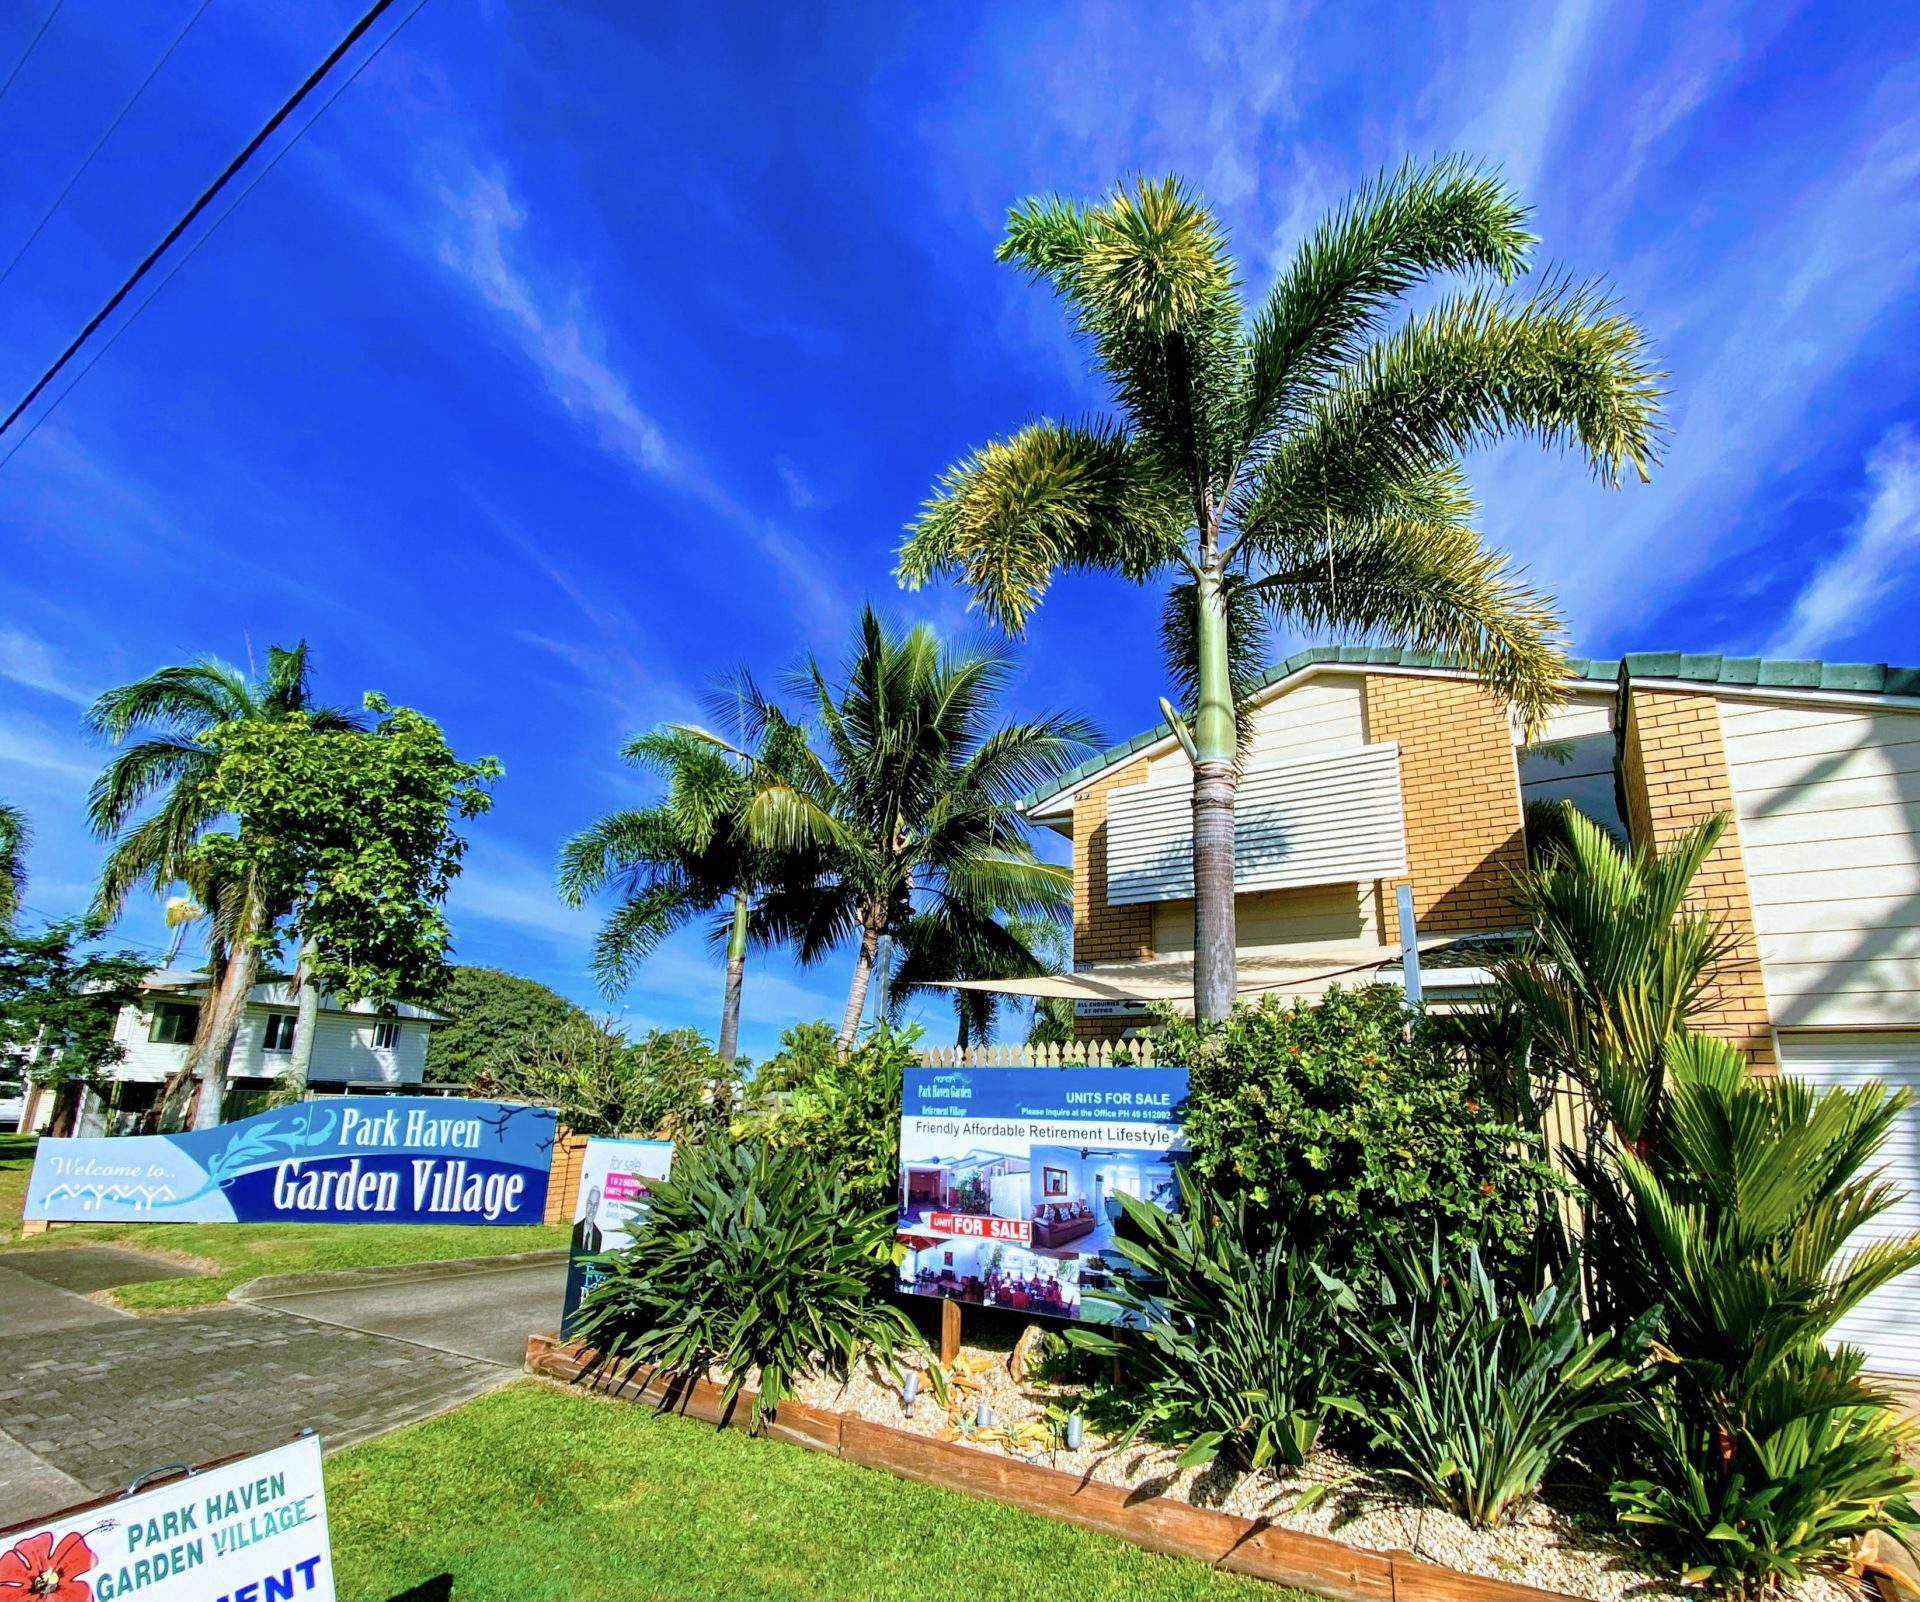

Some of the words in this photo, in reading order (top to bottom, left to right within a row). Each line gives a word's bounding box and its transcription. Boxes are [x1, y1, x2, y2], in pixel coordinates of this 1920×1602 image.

[918, 1084, 931, 1098] Park
[932, 1084, 950, 1098] Haven
[951, 1085, 972, 1098] Garden
[1066, 1092, 1102, 1104] UNITS
[1105, 1092, 1132, 1105] FOR
[1135, 1093, 1170, 1106] SALE
[922, 1105, 948, 1115] Retirement
[949, 1105, 967, 1117] Village
[1021, 1107, 1044, 1115] Please
[1080, 1108, 1092, 1117] the
[1094, 1108, 1116, 1118] Office
[1118, 1109, 1130, 1118] PH
[338, 1107, 398, 1147] Park
[404, 1109, 481, 1149] Haven
[916, 1121, 960, 1137] Friendly
[963, 1123, 1025, 1137] Affordable
[1029, 1125, 1102, 1140] Retirement
[1107, 1127, 1170, 1145] Lifestyle
[50, 1156, 142, 1177] Welcome
[273, 1157, 398, 1212] Garden
[411, 1159, 524, 1221] Village
[954, 1217, 983, 1235] FOR
[990, 1220, 1029, 1240] SALE
[127, 1502, 198, 1553] PARK
[206, 1472, 285, 1524] HAVEN
[96, 1538, 204, 1602] GARDEN
[211, 1498, 308, 1555] VILLAGE
